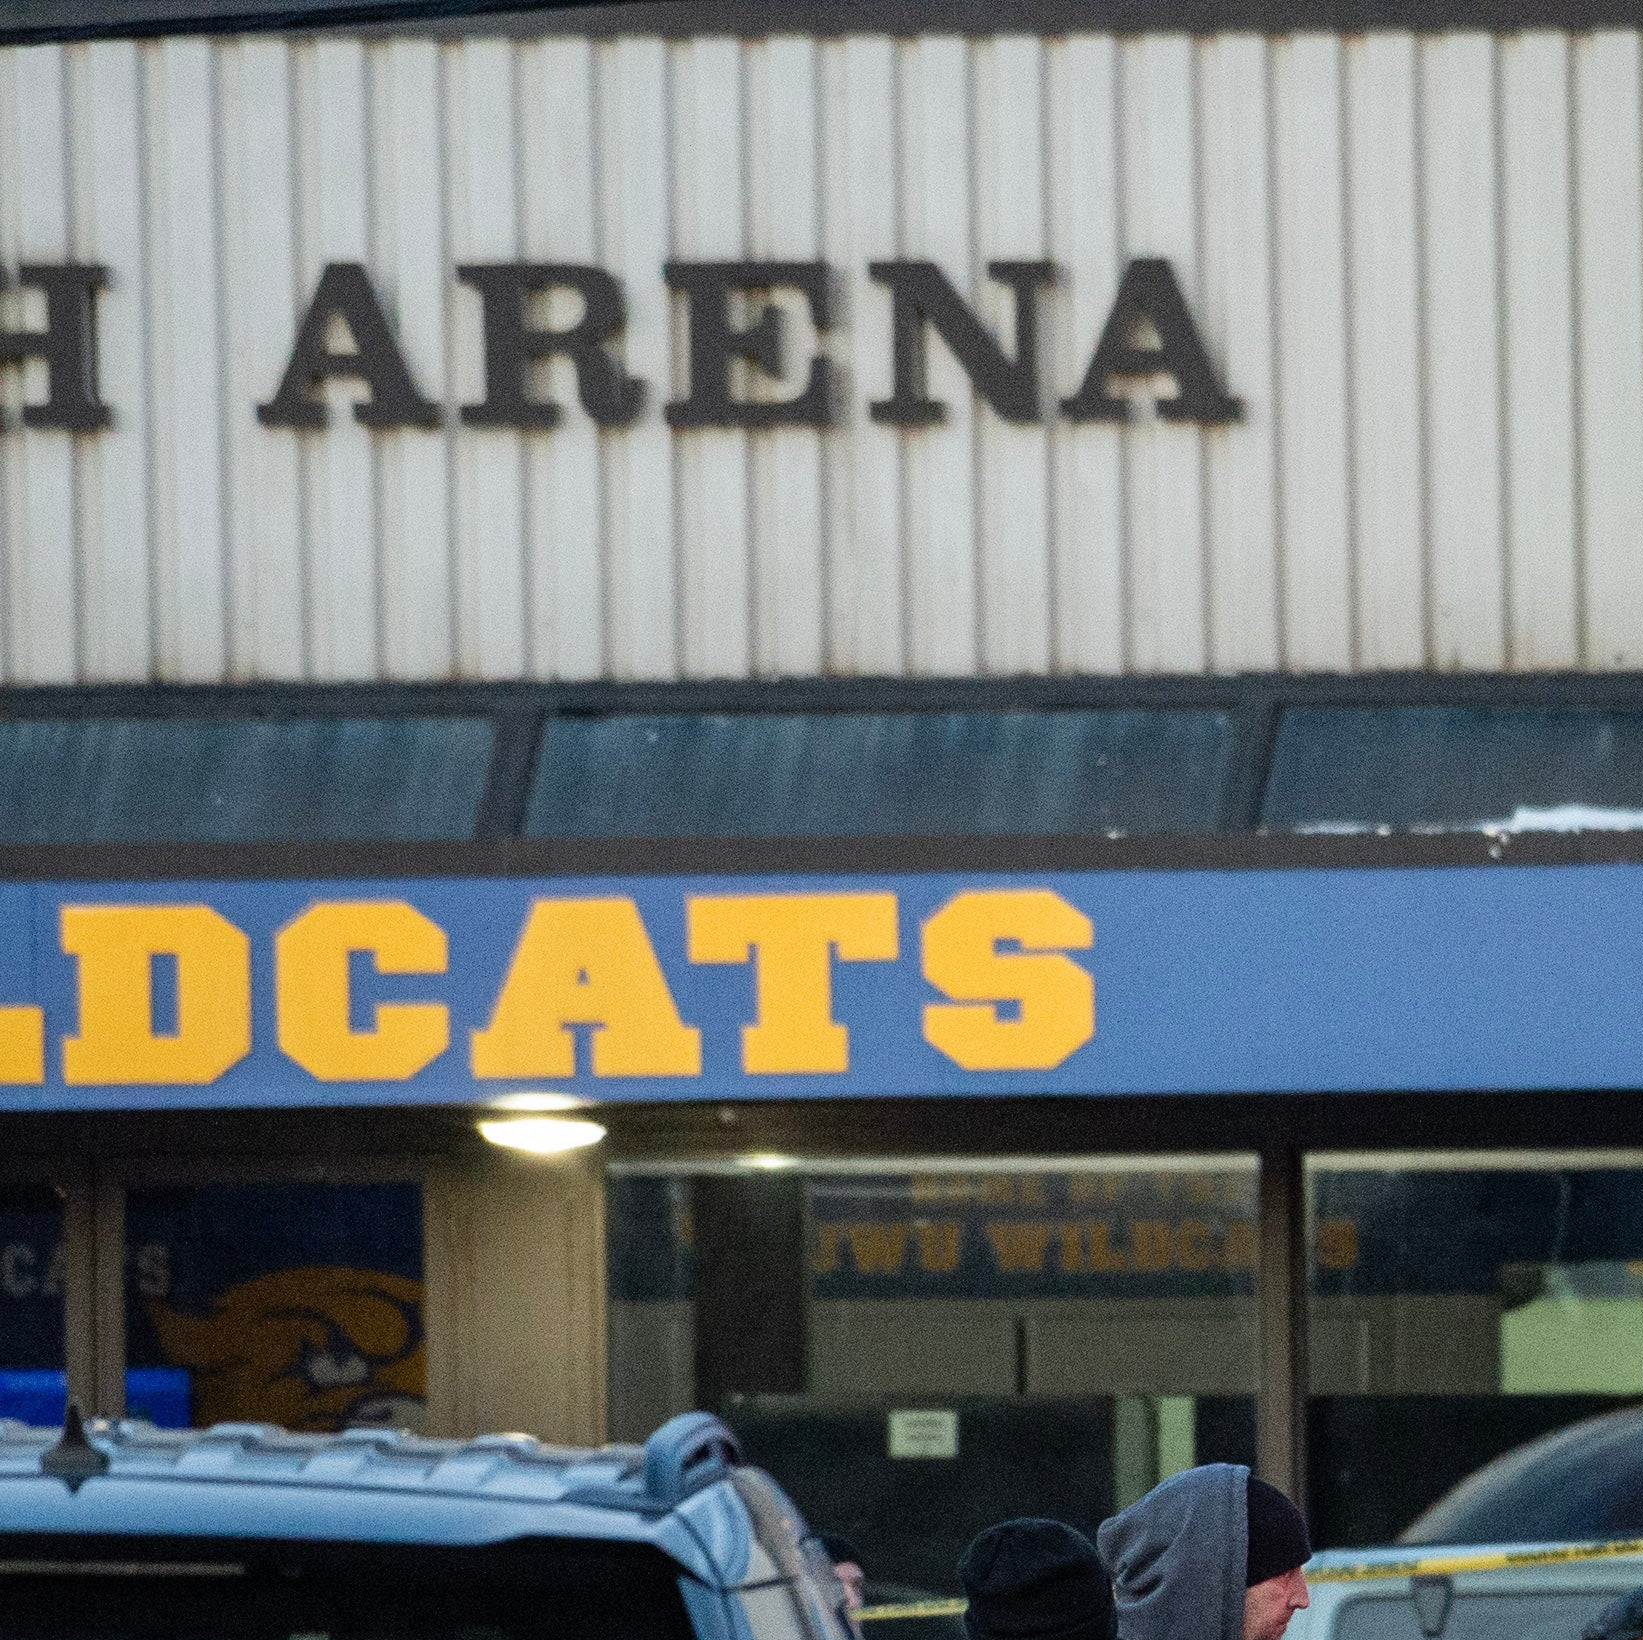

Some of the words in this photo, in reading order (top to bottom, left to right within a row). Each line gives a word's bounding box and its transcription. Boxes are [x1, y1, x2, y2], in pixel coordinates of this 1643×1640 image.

[256, 257, 1246, 432] ARENA
[0, 888, 1096, 1085] DCATS
[2, 1243, 171, 1298] CAS
[987, 1221, 1357, 1271] WILDCAS
